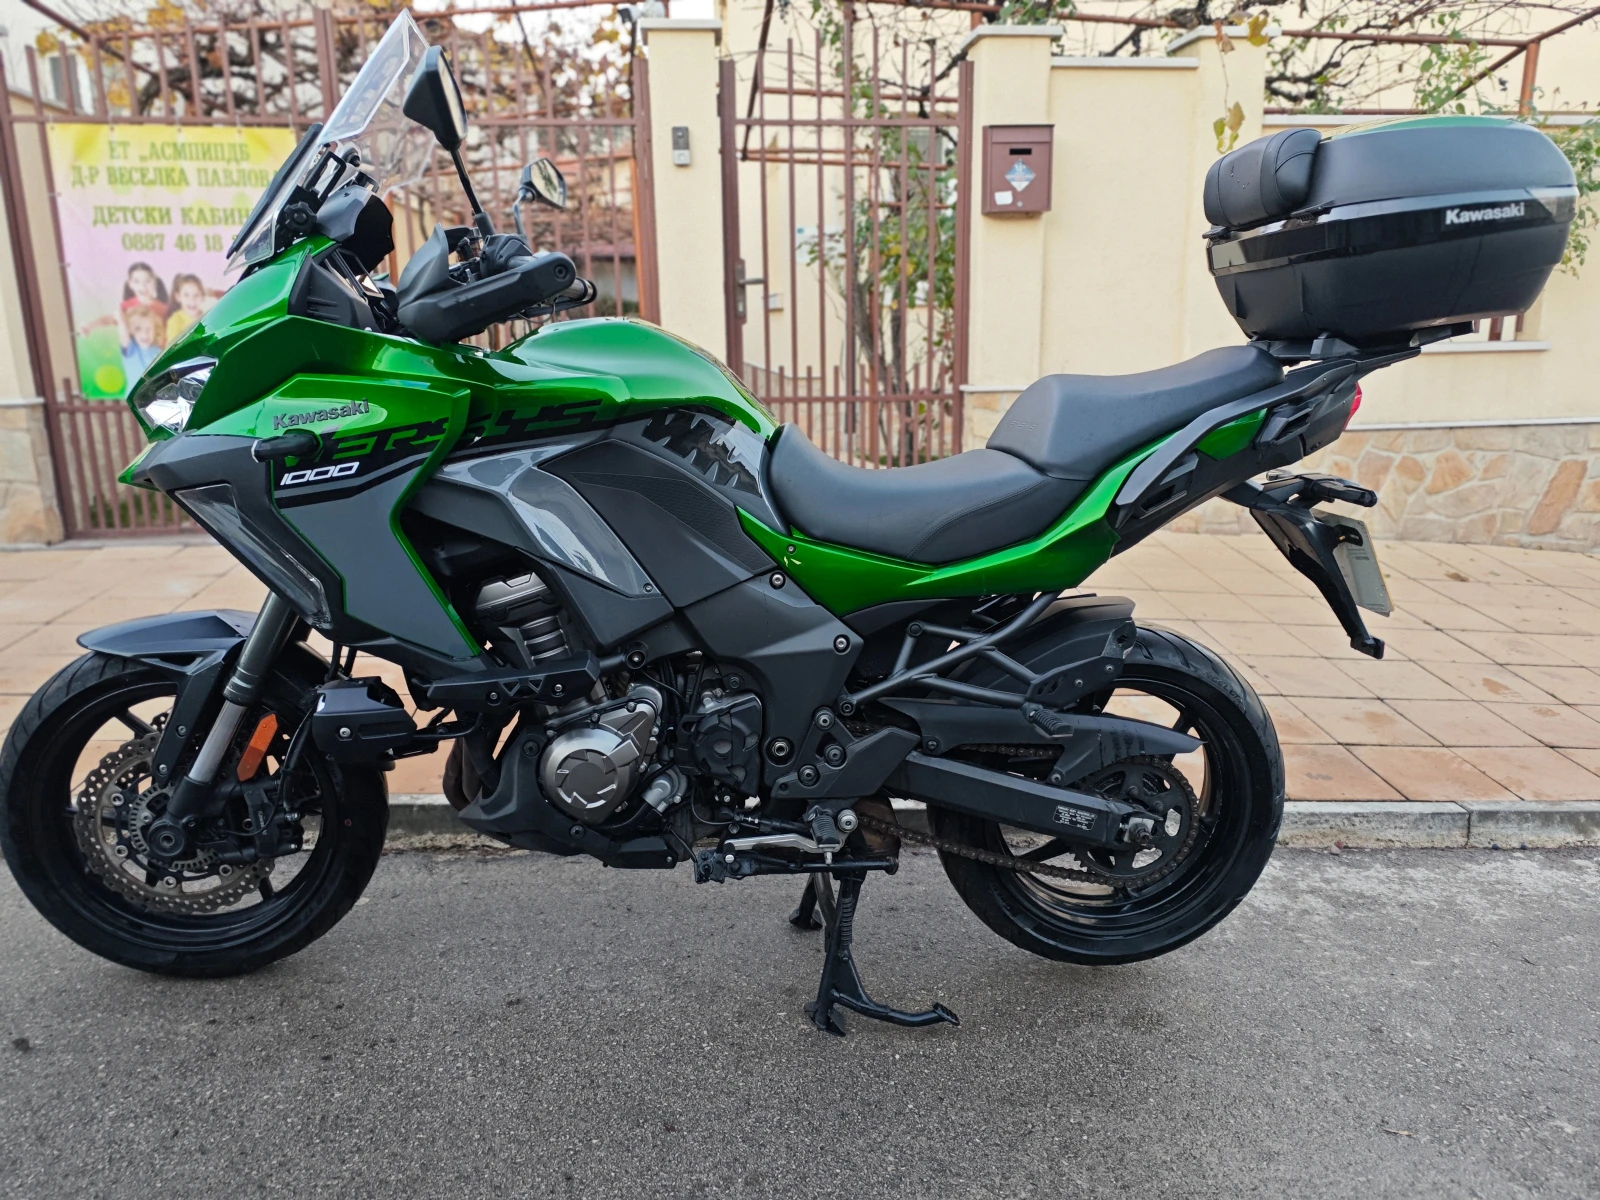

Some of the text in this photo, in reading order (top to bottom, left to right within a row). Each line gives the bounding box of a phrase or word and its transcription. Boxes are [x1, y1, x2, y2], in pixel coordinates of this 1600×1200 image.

[108, 140, 130, 160] ЕТ
[106, 166, 190, 187] ВЕСЕЛКА
[196, 168, 278, 187] ПАВЛОВ
[92, 206, 254, 228] ДЕТСКИ КАБИН
[1445, 202, 1525, 225] Kawasaki
[121, 232, 165, 252] 0887
[174, 233, 197, 252] 46
[204, 233, 223, 252] 18
[272, 398, 370, 430] Kawasaki
[280, 461, 360, 486] 1000
